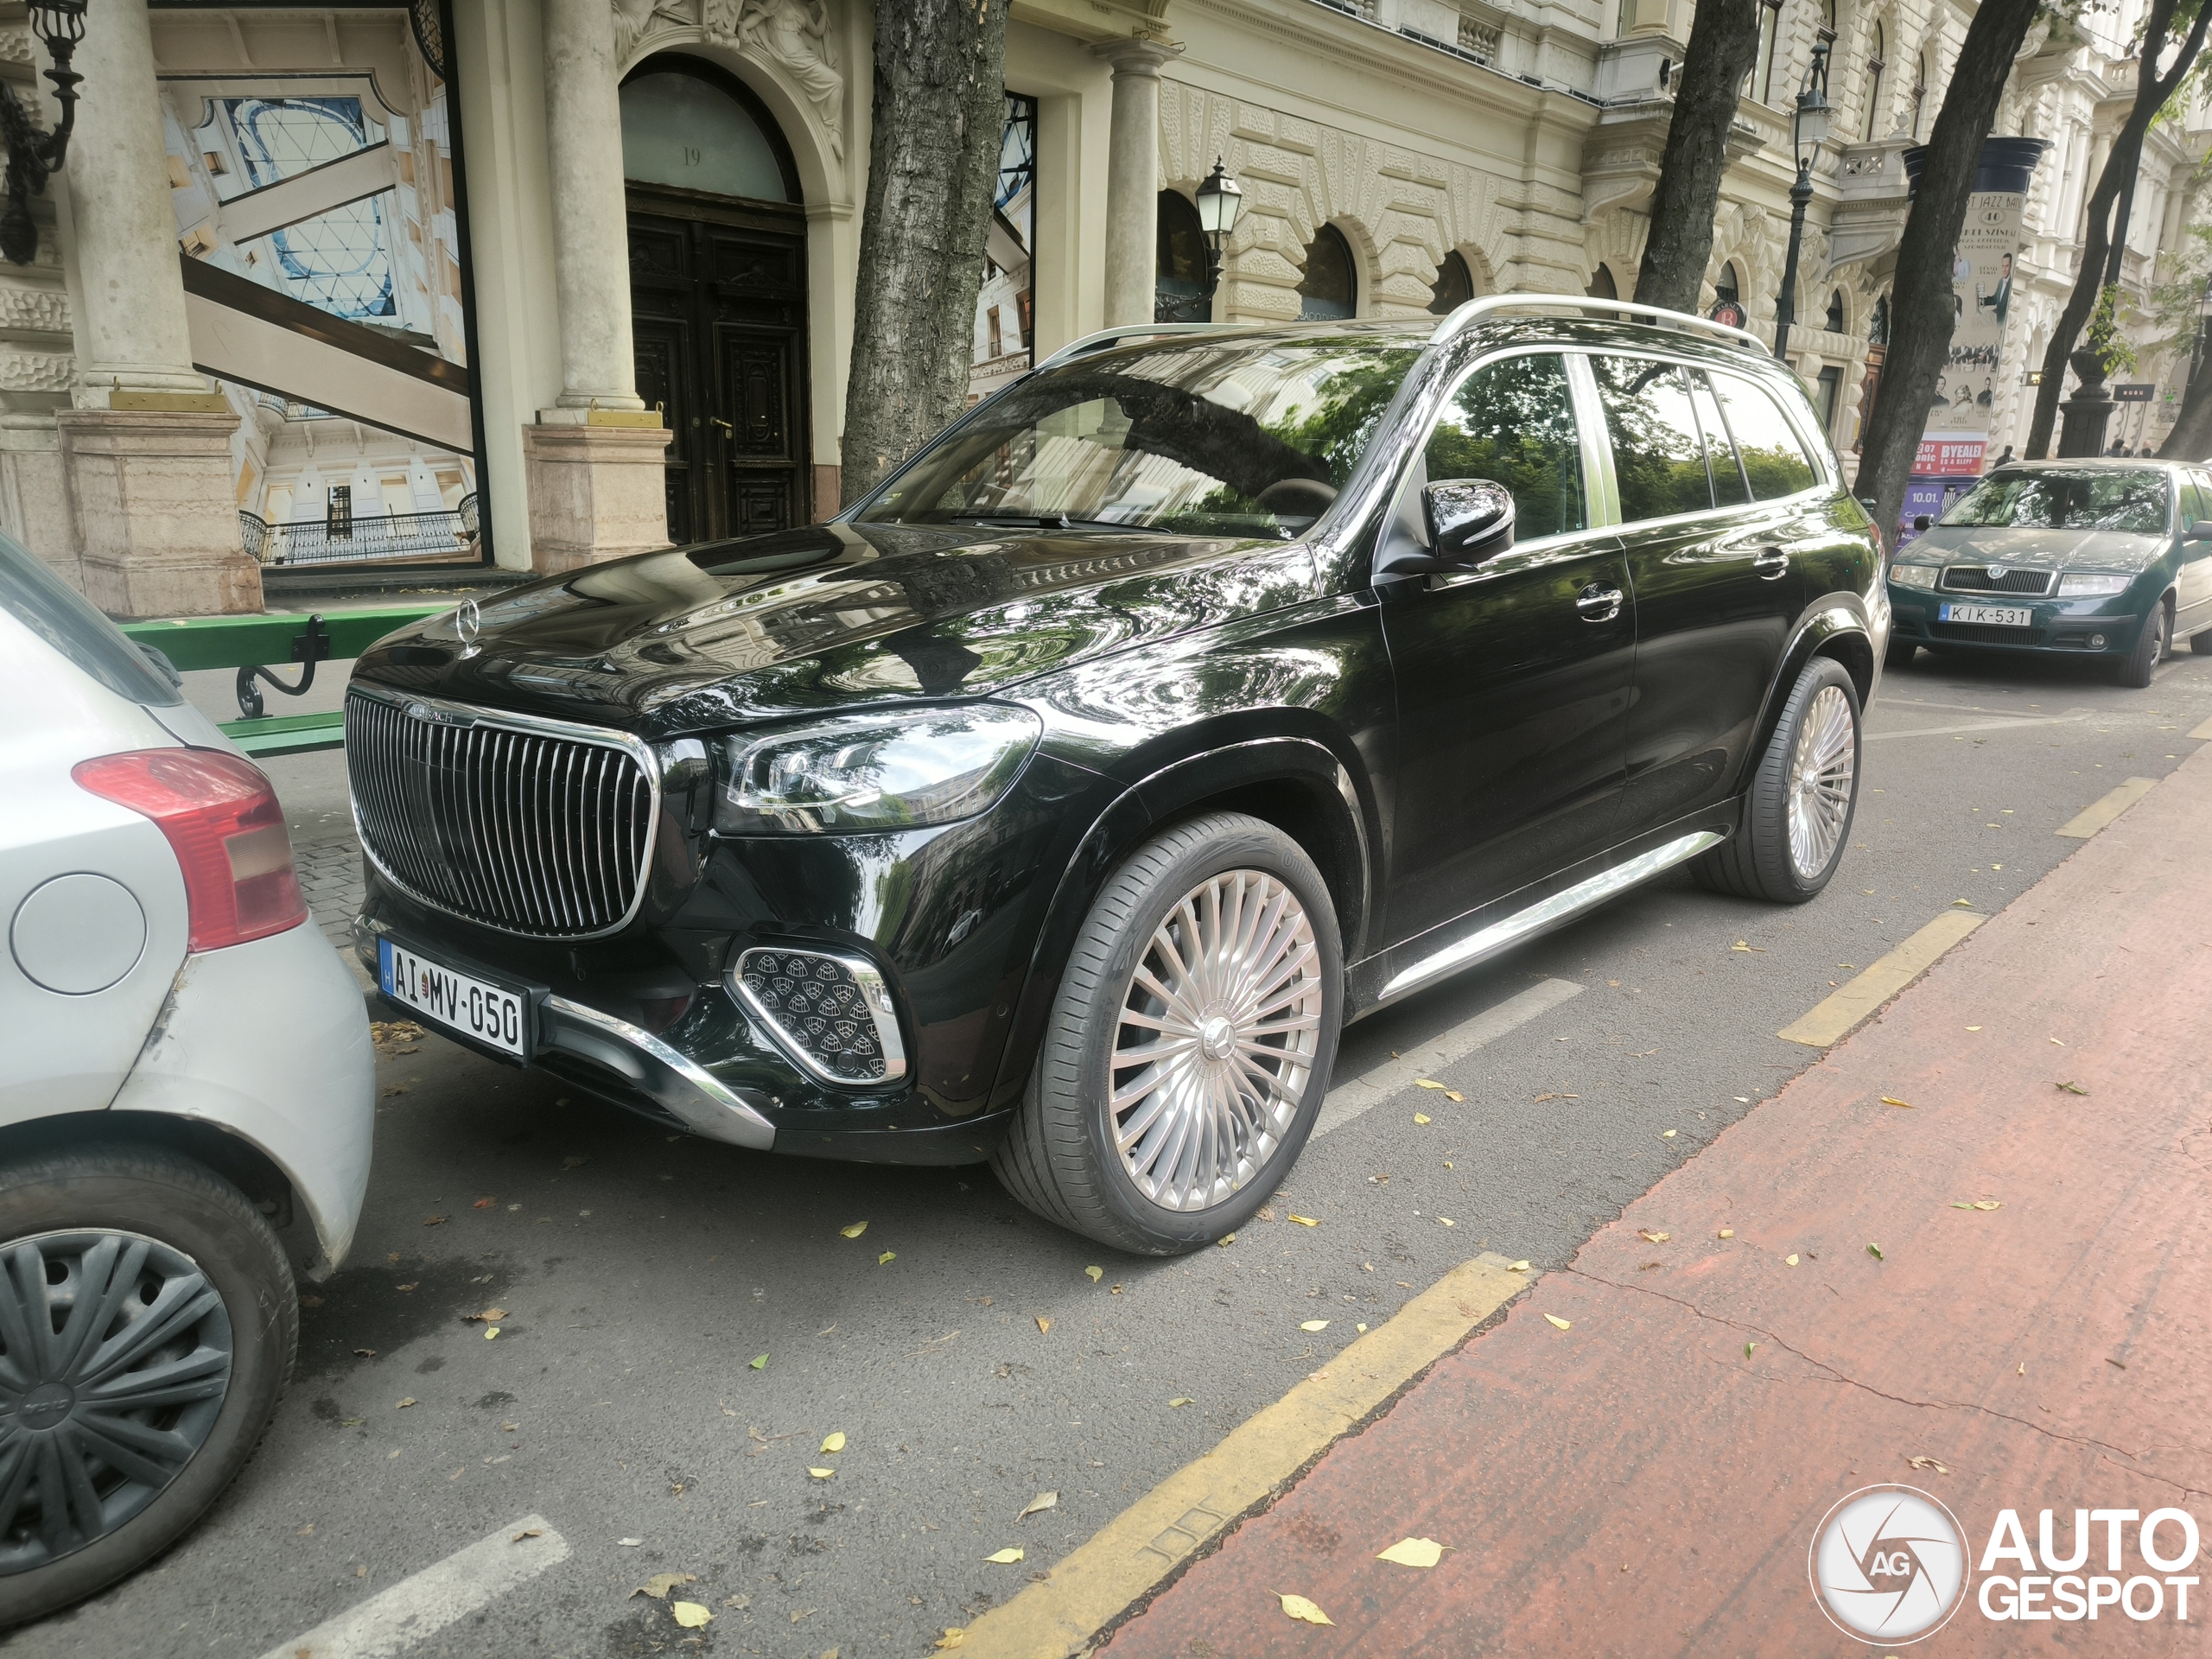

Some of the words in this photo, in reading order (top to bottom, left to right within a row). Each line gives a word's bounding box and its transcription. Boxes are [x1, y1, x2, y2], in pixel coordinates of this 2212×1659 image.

[683, 146, 701, 168] 19
[1979, 195, 2002, 209] JAZZ
[1984, 212, 2000, 221] 40
[1941, 444, 1982, 458] BYEALEX
[1912, 493, 1938, 503] 10.01.
[1952, 607, 2025, 624] KIK-531
[385, 971, 391, 986] H
